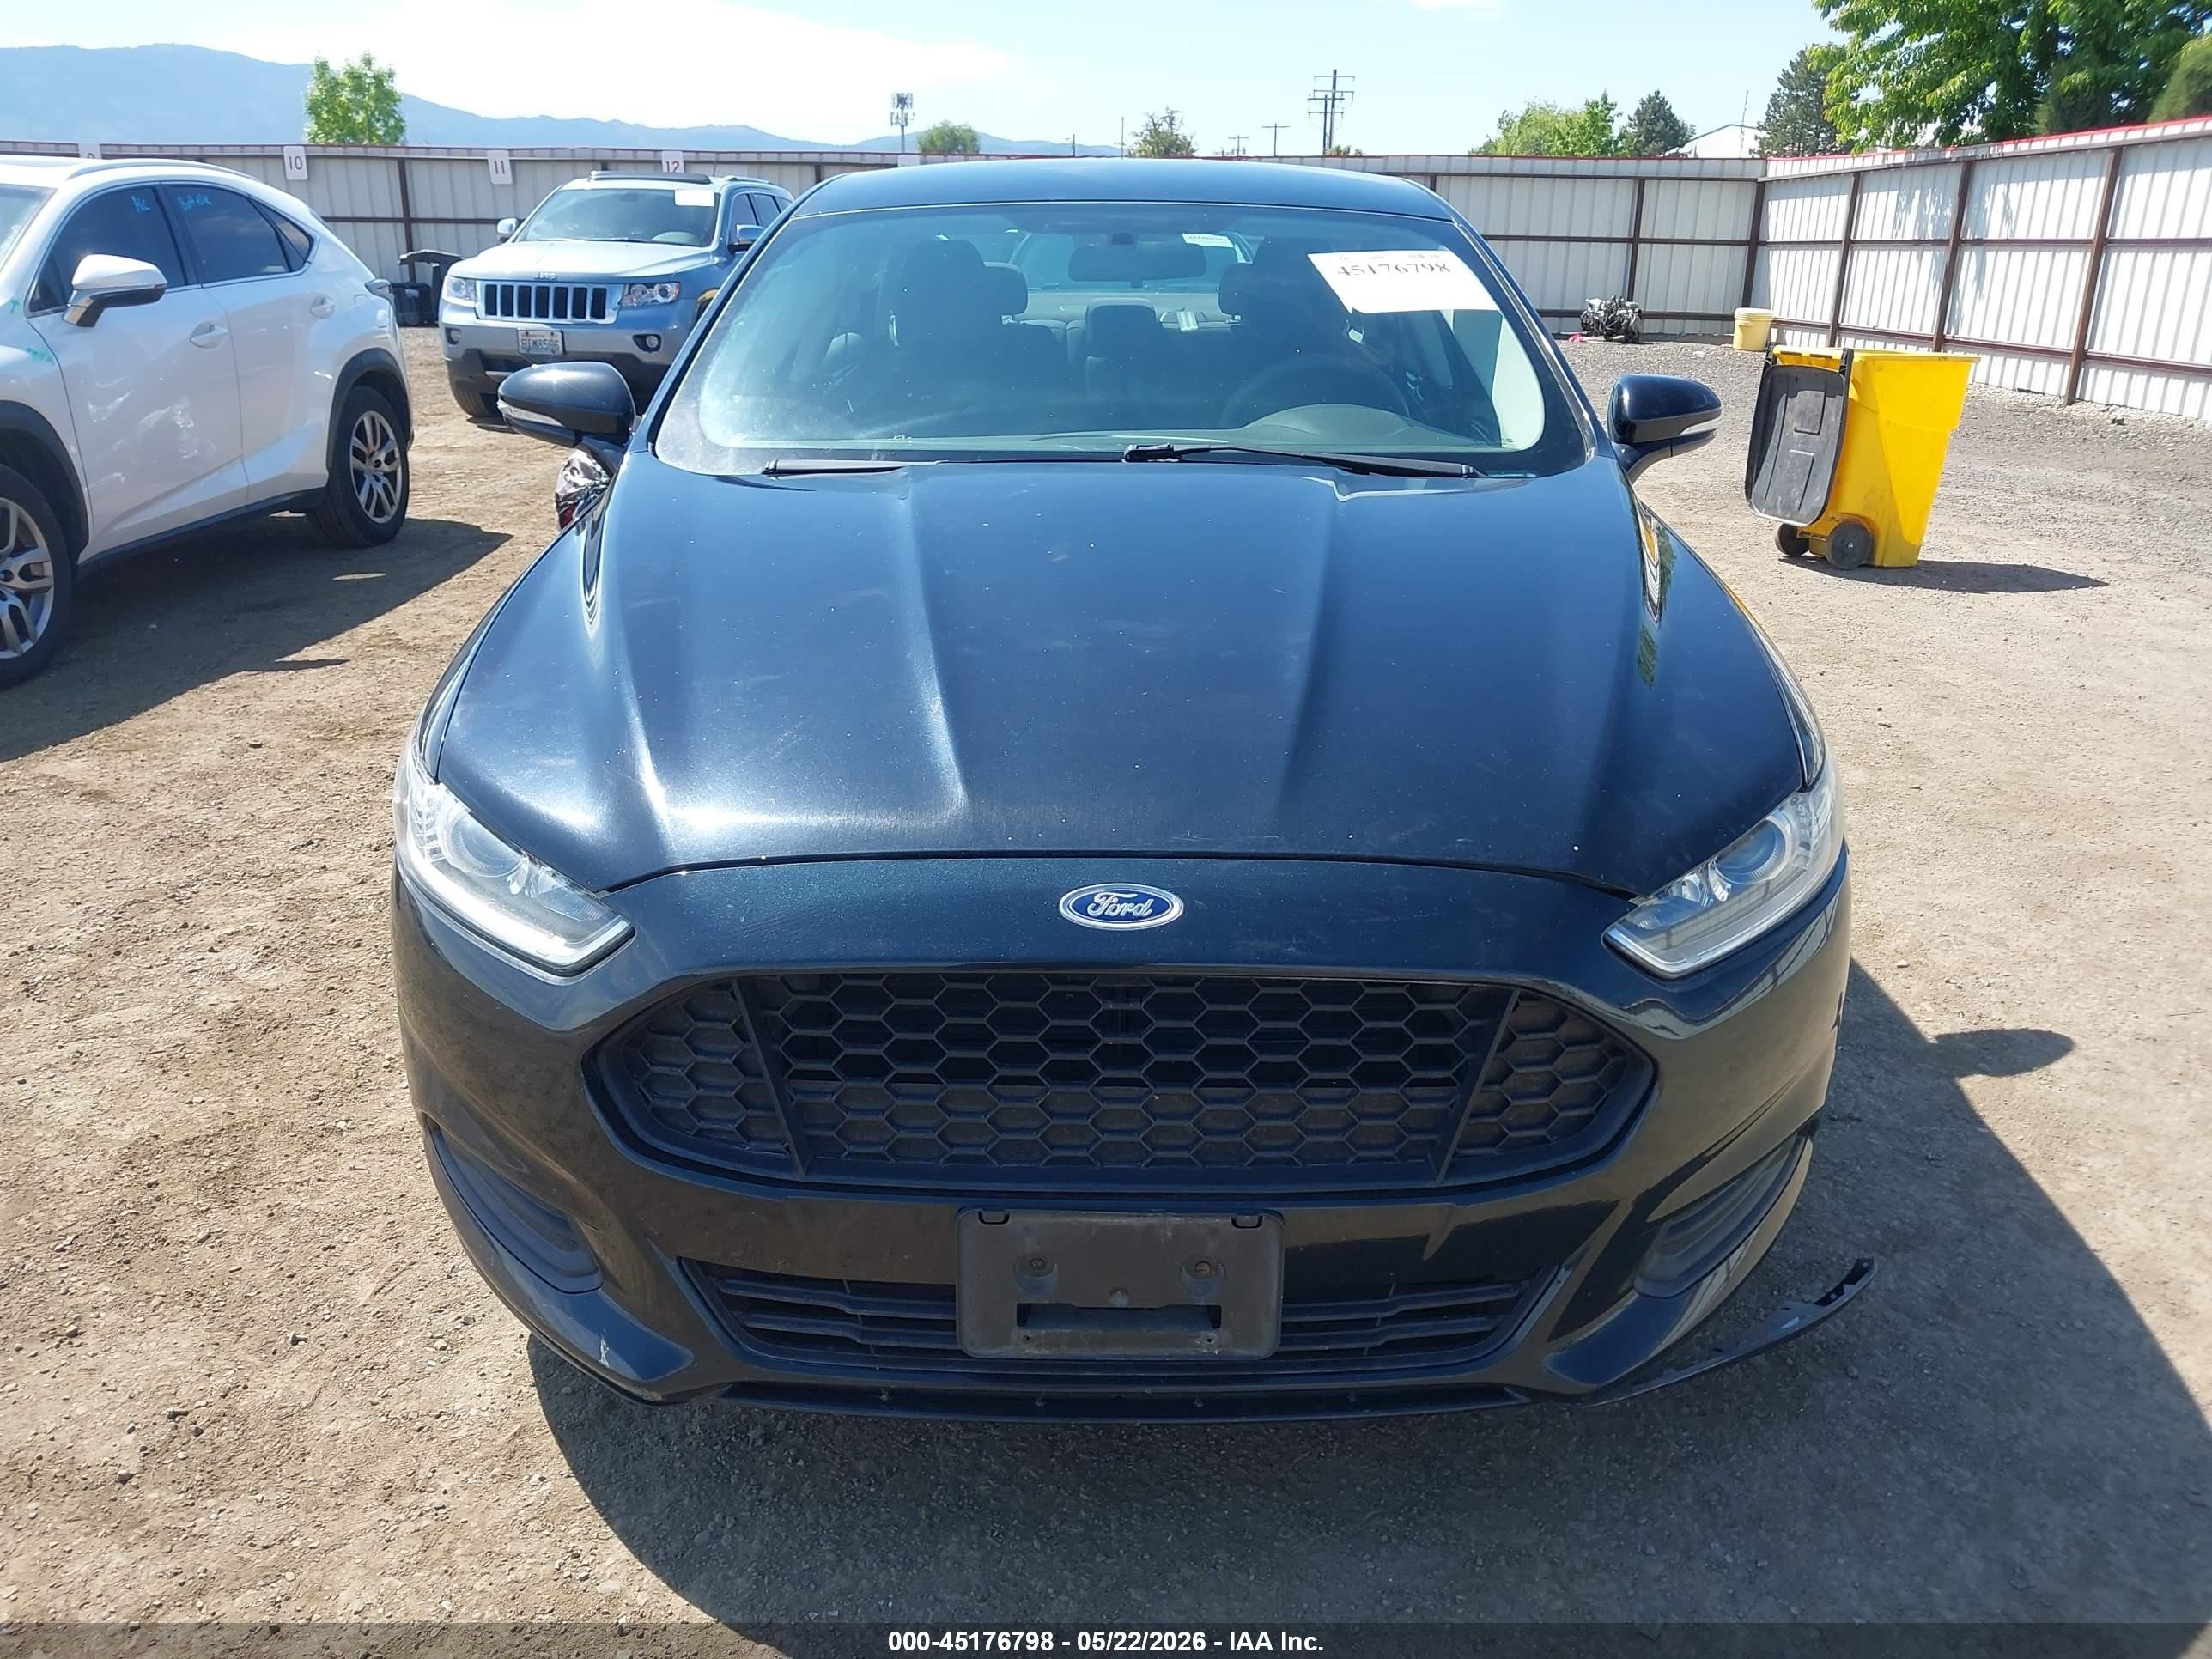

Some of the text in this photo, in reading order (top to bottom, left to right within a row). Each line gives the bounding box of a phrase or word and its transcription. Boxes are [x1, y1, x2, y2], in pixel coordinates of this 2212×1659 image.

[288, 155, 303, 171] 10
[494, 160, 505, 174] 11
[665, 161, 680, 173] 12
[1338, 263, 1451, 276] 45176798
[1086, 891, 1155, 918] Ford
